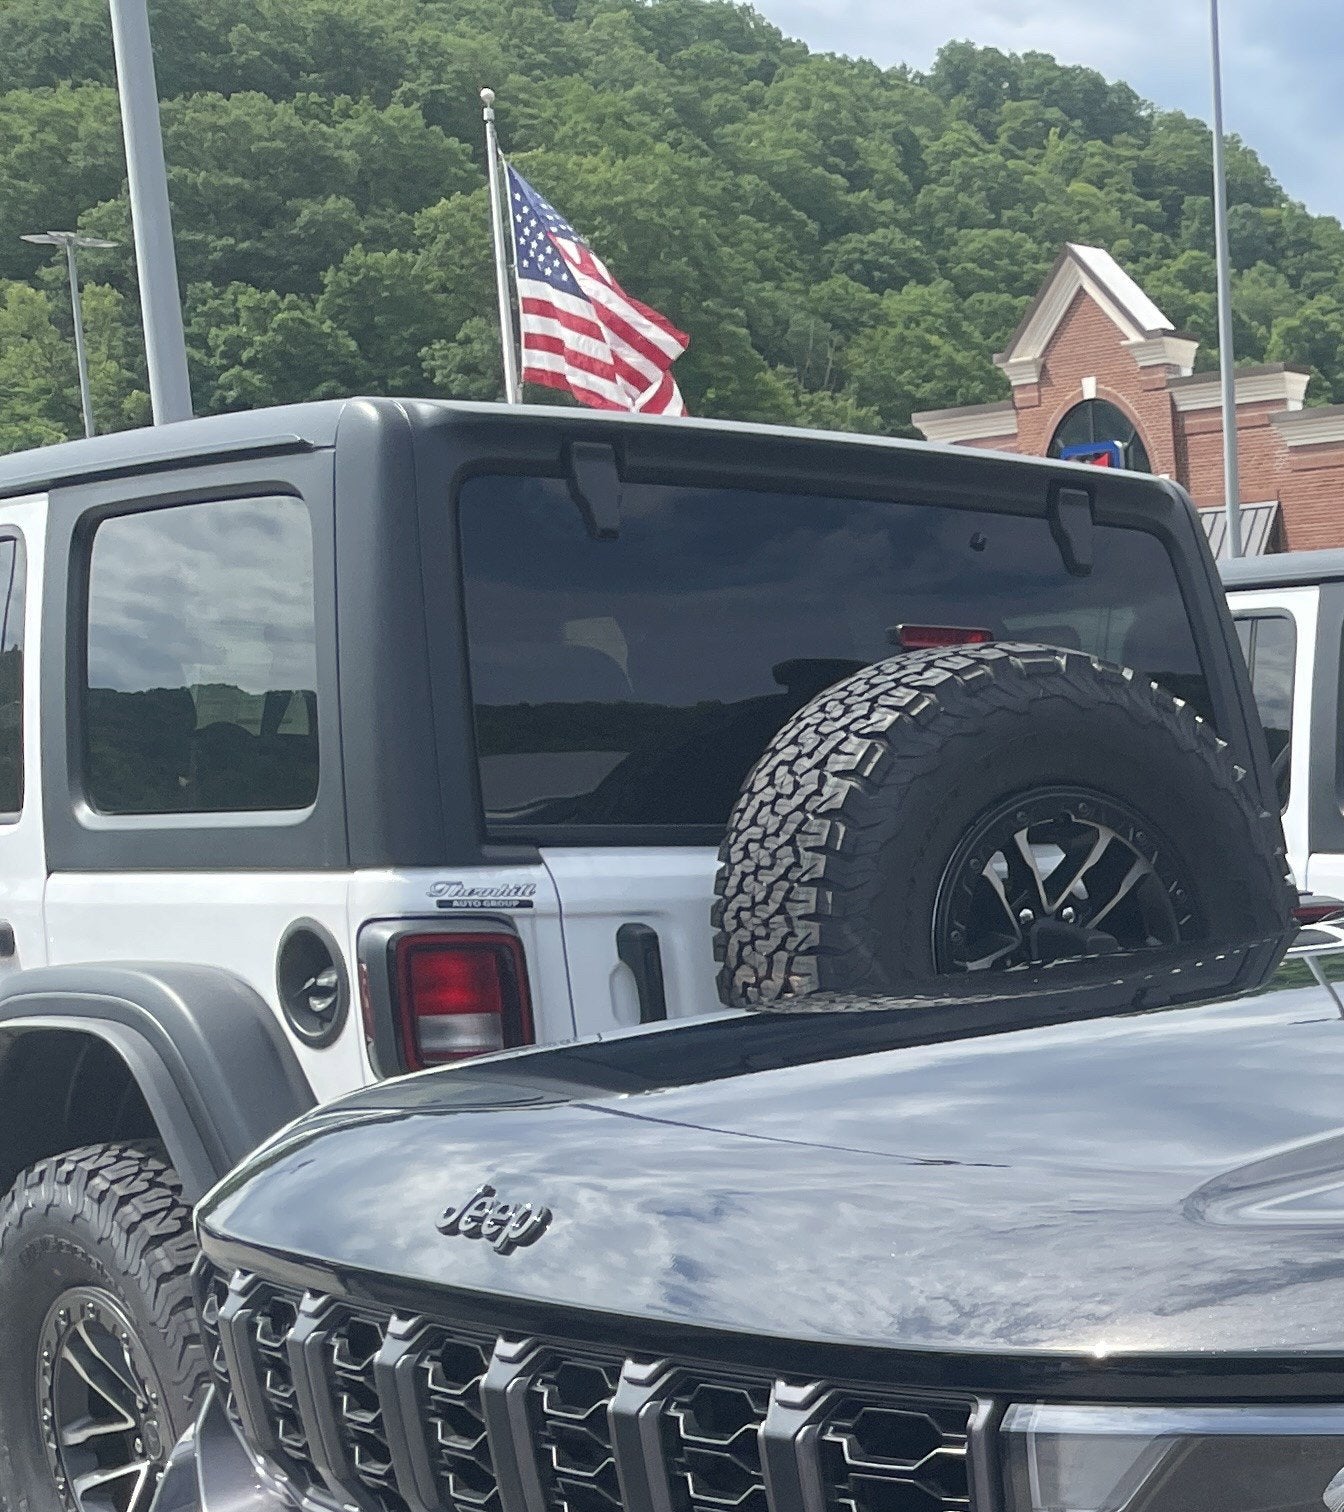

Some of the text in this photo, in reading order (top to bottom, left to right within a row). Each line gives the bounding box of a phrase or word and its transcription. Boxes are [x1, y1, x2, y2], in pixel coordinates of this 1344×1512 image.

[426, 881, 537, 898] Thornhill
[452, 900, 521, 908] AUTO GROUP
[435, 1184, 553, 1256] Jeep
